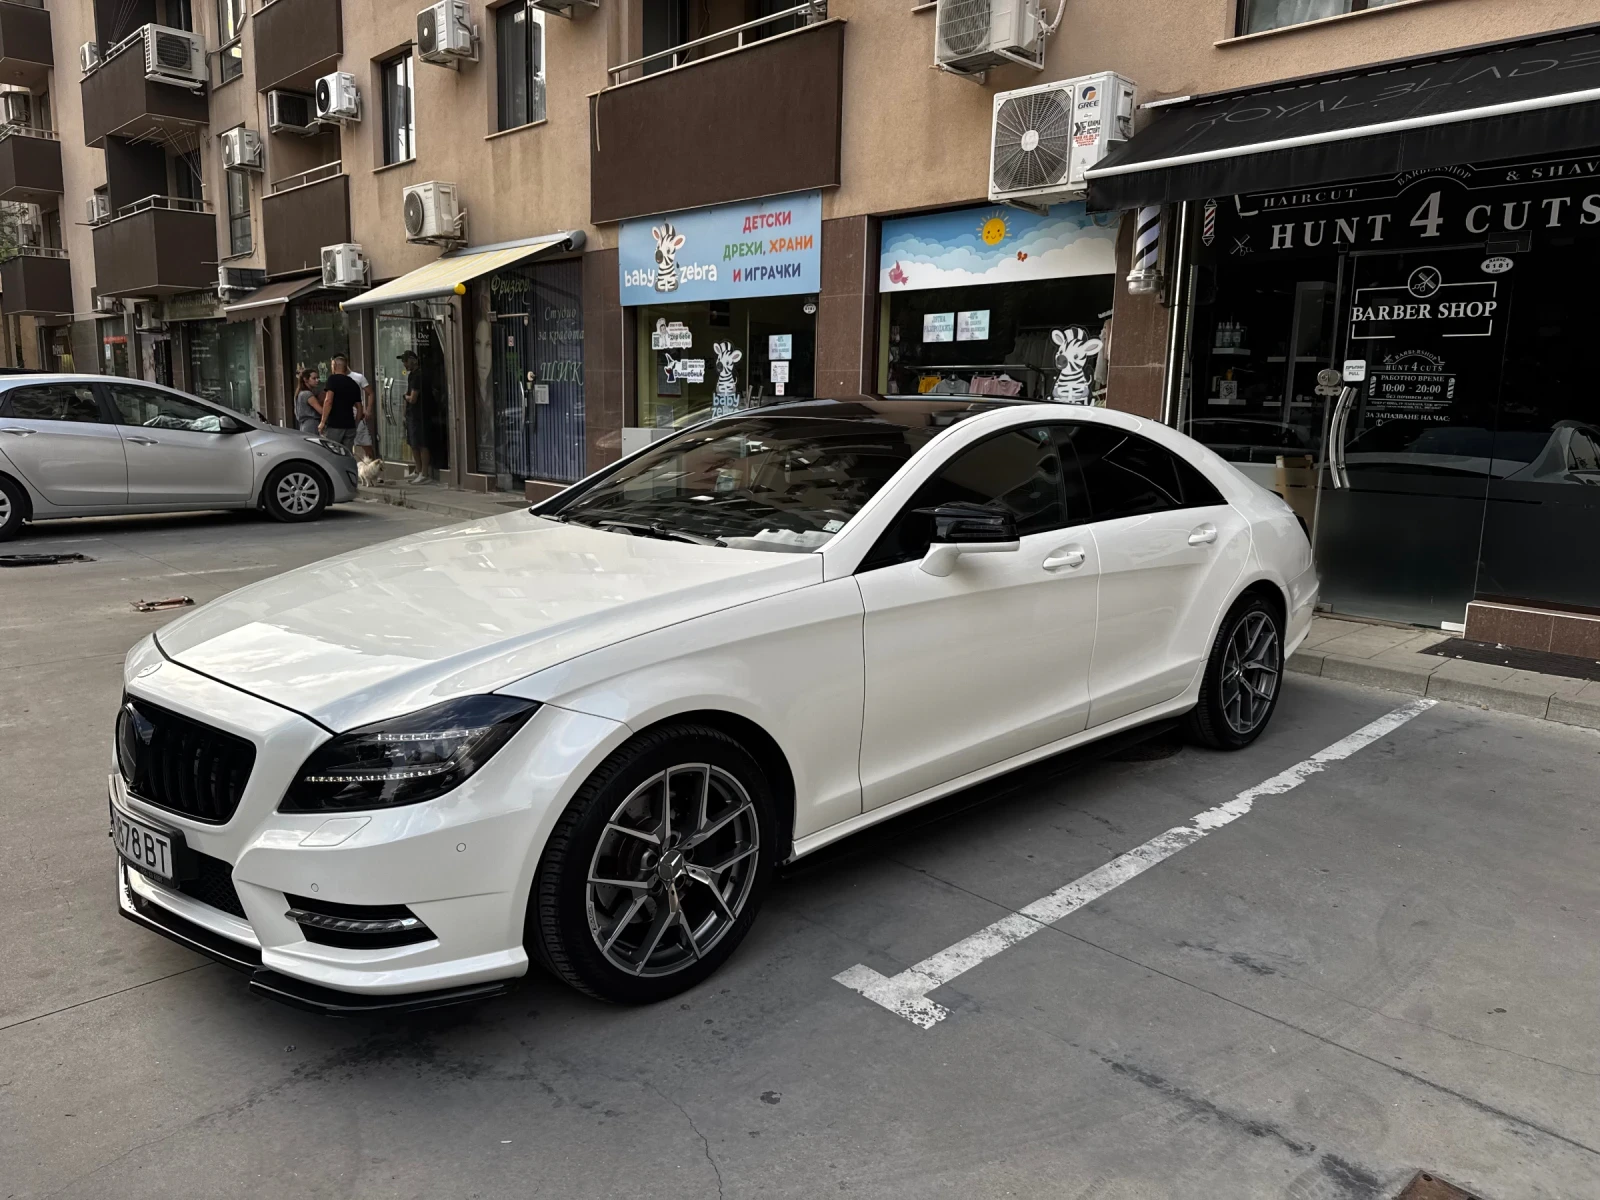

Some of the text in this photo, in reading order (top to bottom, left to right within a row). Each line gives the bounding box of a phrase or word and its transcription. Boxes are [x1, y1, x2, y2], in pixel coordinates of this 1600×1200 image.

[1078, 100, 1099, 109] GREE
[1186, 95, 1364, 131] ROYAL
[1263, 188, 1358, 208] HAIRCUT
[1505, 170, 1521, 182] &
[742, 210, 792, 234] ДЕТСКИ
[1270, 189, 1600, 250] HUNT 4 CUTS
[722, 235, 813, 262] ДРЕХИ, ХРАНИ
[624, 263, 718, 288] baby zebra
[733, 262, 801, 283] И ИГРАЧКИ
[544, 305, 577, 324] Студио
[1351, 301, 1498, 323] BARBER SHOP
[537, 329, 585, 344] за красота
[1394, 349, 1438, 361] BARBERSHOP
[540, 360, 584, 386] ШИК
[1411, 361, 1418, 371] 4
[1381, 383, 1405, 393] 10:00
[1415, 384, 1441, 394] 20:00
[712, 392, 740, 407] baby
[1376, 412, 1420, 421] ЗАПАЗВАНЕ
